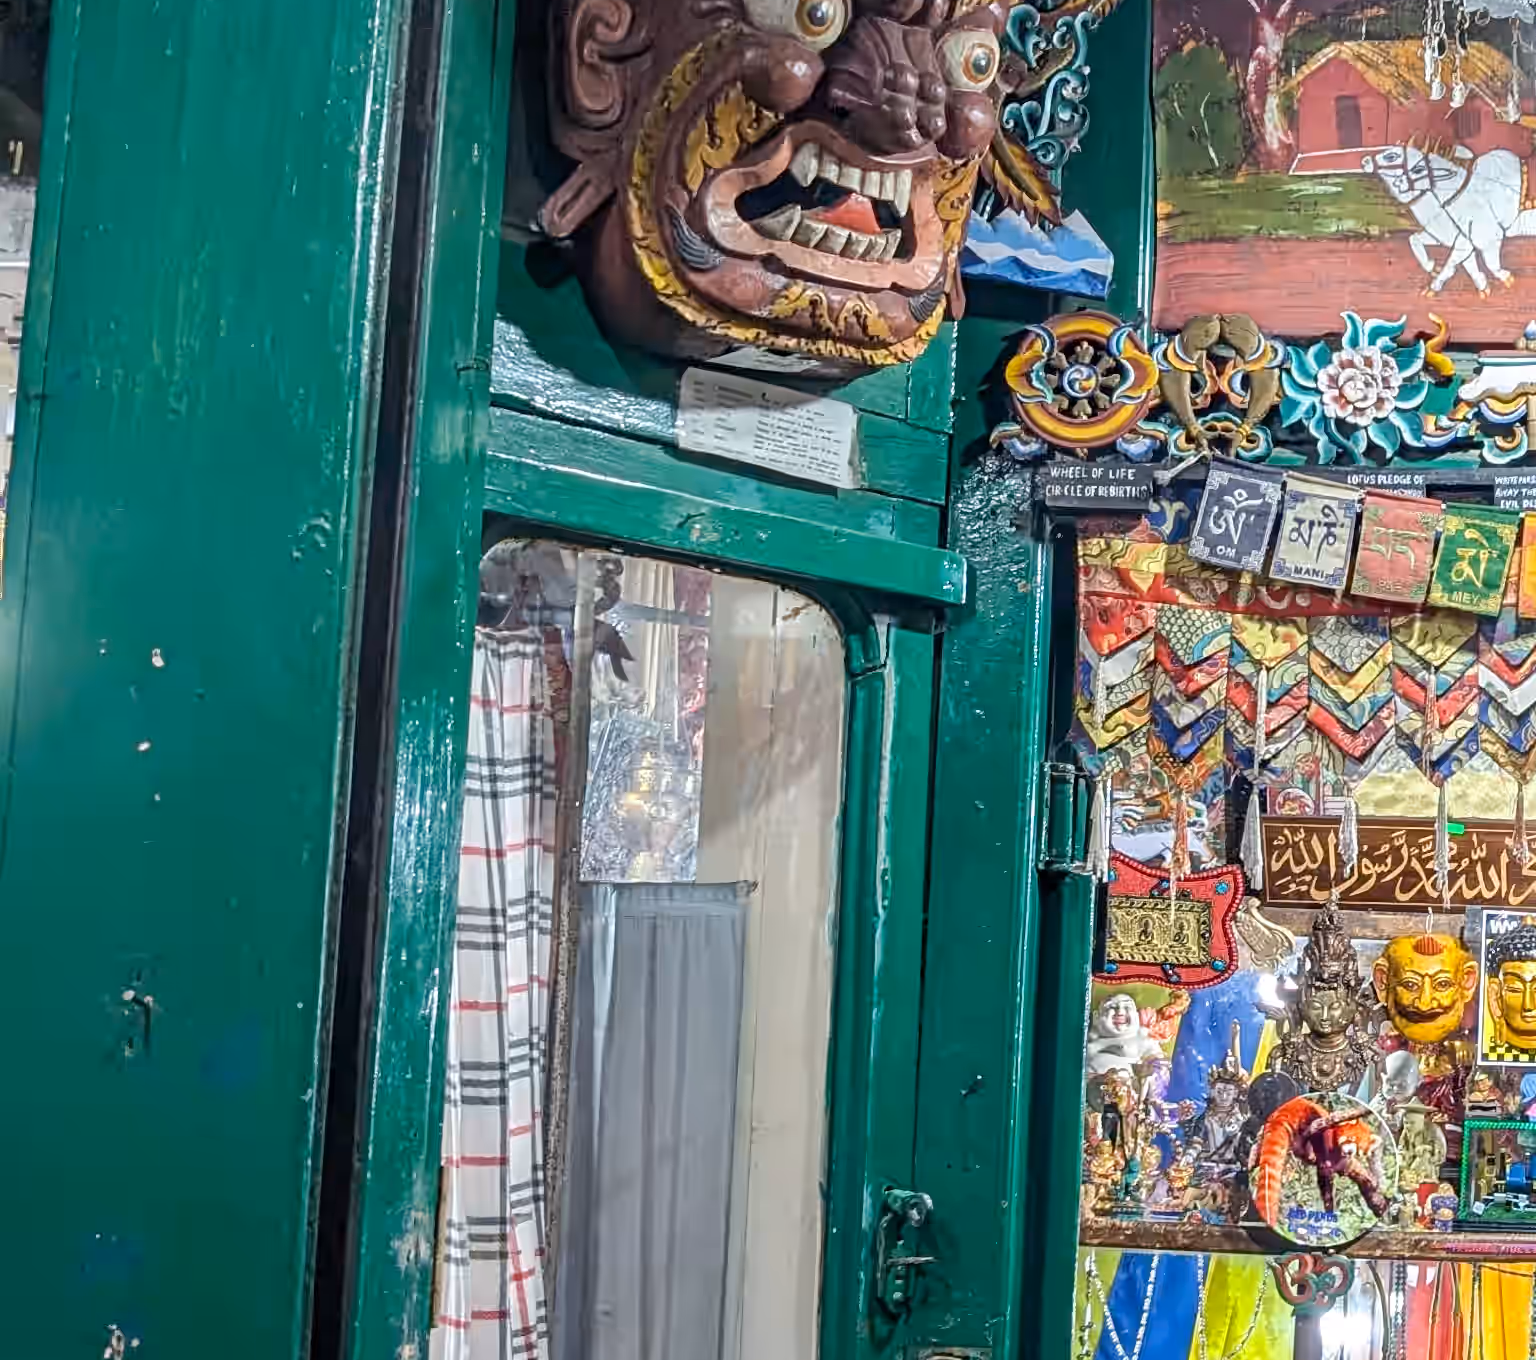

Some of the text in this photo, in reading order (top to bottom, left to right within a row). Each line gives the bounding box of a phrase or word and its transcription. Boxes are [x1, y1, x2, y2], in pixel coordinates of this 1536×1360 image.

[1050, 466, 1136, 480] WHEEL OF LIFE
[1347, 474, 1426, 485] LOTUS PLEDGE OF
[1045, 484, 1083, 497] CIRCLE
[1084, 485, 1098, 497] OF
[1500, 499, 1520, 509] EVIL
[1216, 545, 1237, 557] OM
[1293, 566, 1326, 579] MANI
[1452, 591, 1480, 605] MEY
